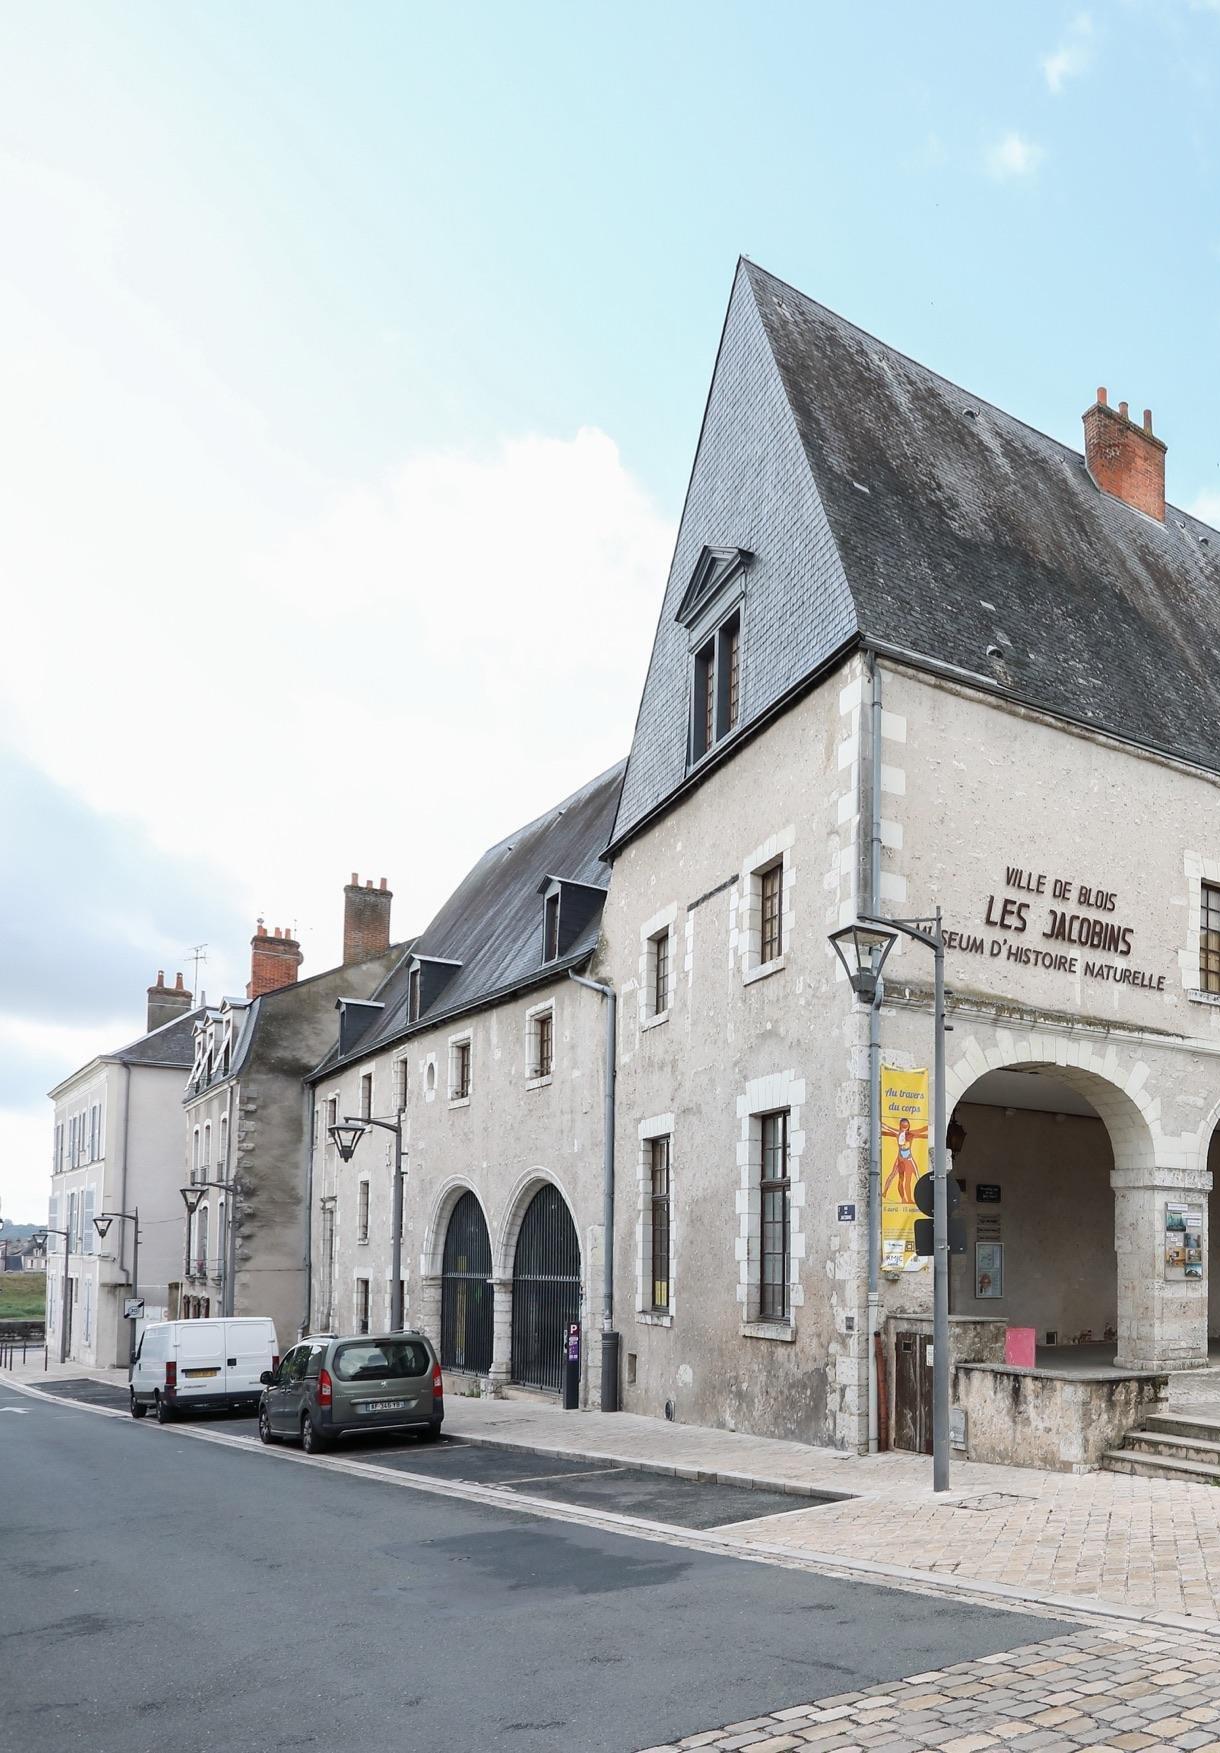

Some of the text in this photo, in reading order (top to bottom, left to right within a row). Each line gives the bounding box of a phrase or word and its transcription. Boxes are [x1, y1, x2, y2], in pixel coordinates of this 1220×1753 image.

[1006, 865, 1118, 912] VILLE DE BLOIS
[985, 894, 1134, 956] LES JACOBINS
[990, 938, 1079, 974] D'HISTOIRE
[1084, 960, 1166, 992] NATURELLE
[888, 1103, 921, 1115] du corps
[899, 1090, 925, 1100] travers
[570, 1324, 578, 1334] P
